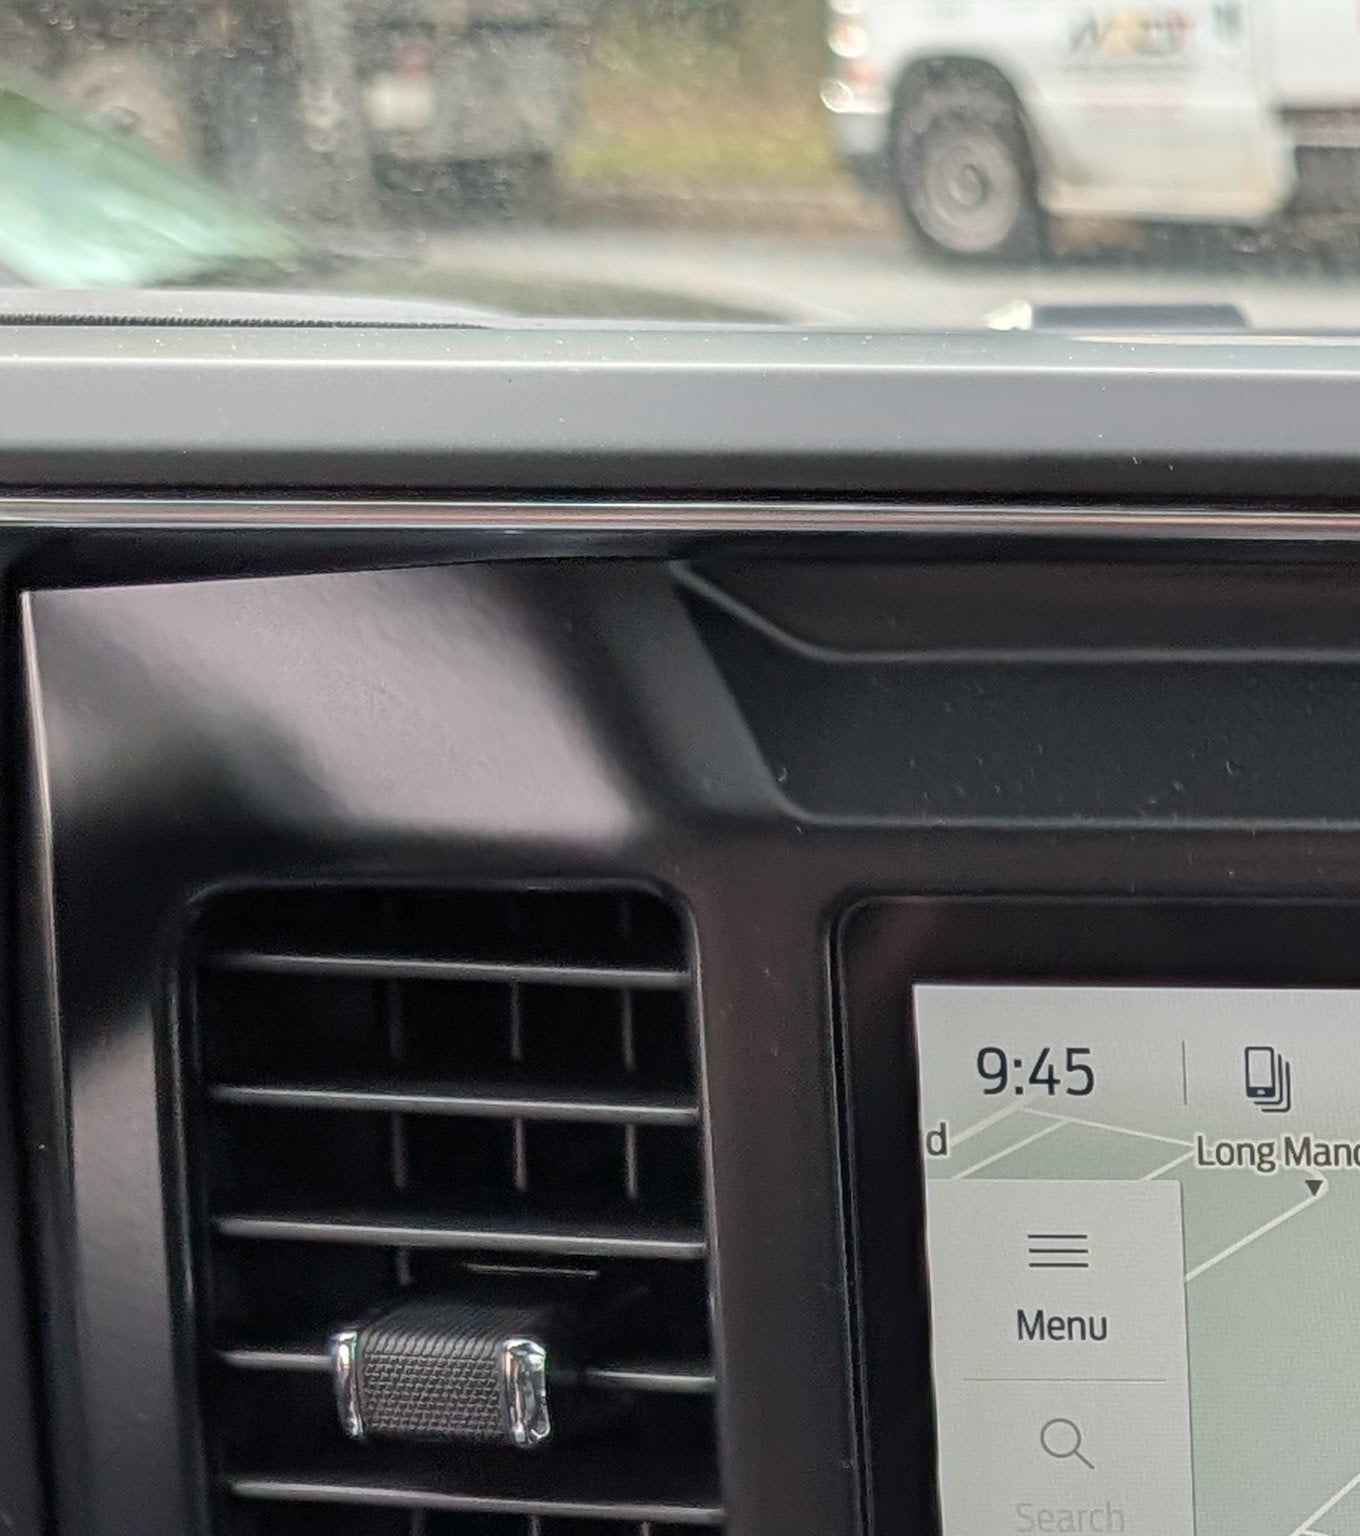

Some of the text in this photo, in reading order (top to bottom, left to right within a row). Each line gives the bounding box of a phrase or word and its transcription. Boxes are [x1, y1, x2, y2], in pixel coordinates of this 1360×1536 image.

[976, 1046, 1094, 1096] 9:45
[1197, 1135, 1276, 1173] Long
[1016, 1309, 1107, 1341] Menu
[1015, 1501, 1125, 1534] Search
